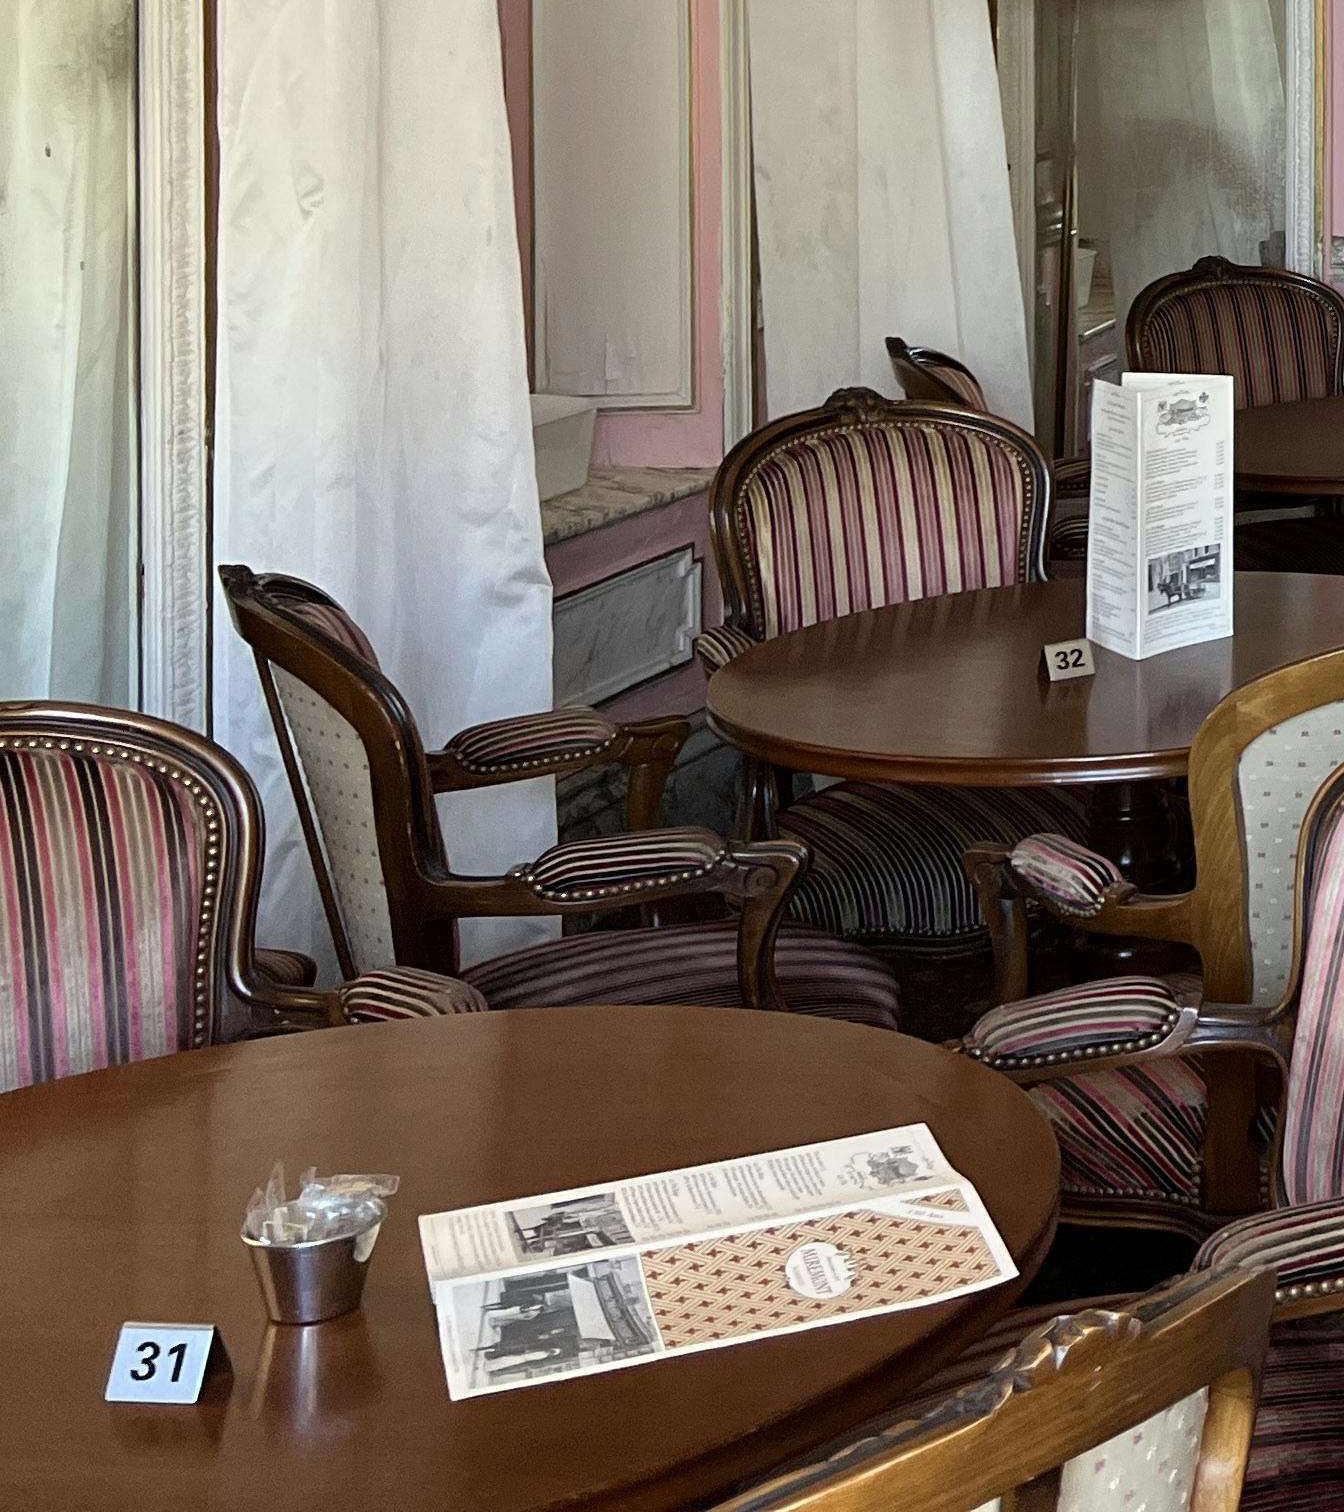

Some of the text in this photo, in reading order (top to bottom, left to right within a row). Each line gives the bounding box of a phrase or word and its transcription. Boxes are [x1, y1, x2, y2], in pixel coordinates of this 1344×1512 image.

[1055, 649, 1085, 670] 32
[801, 1249, 832, 1295] MIREMONT
[130, 1341, 187, 1382] 31
